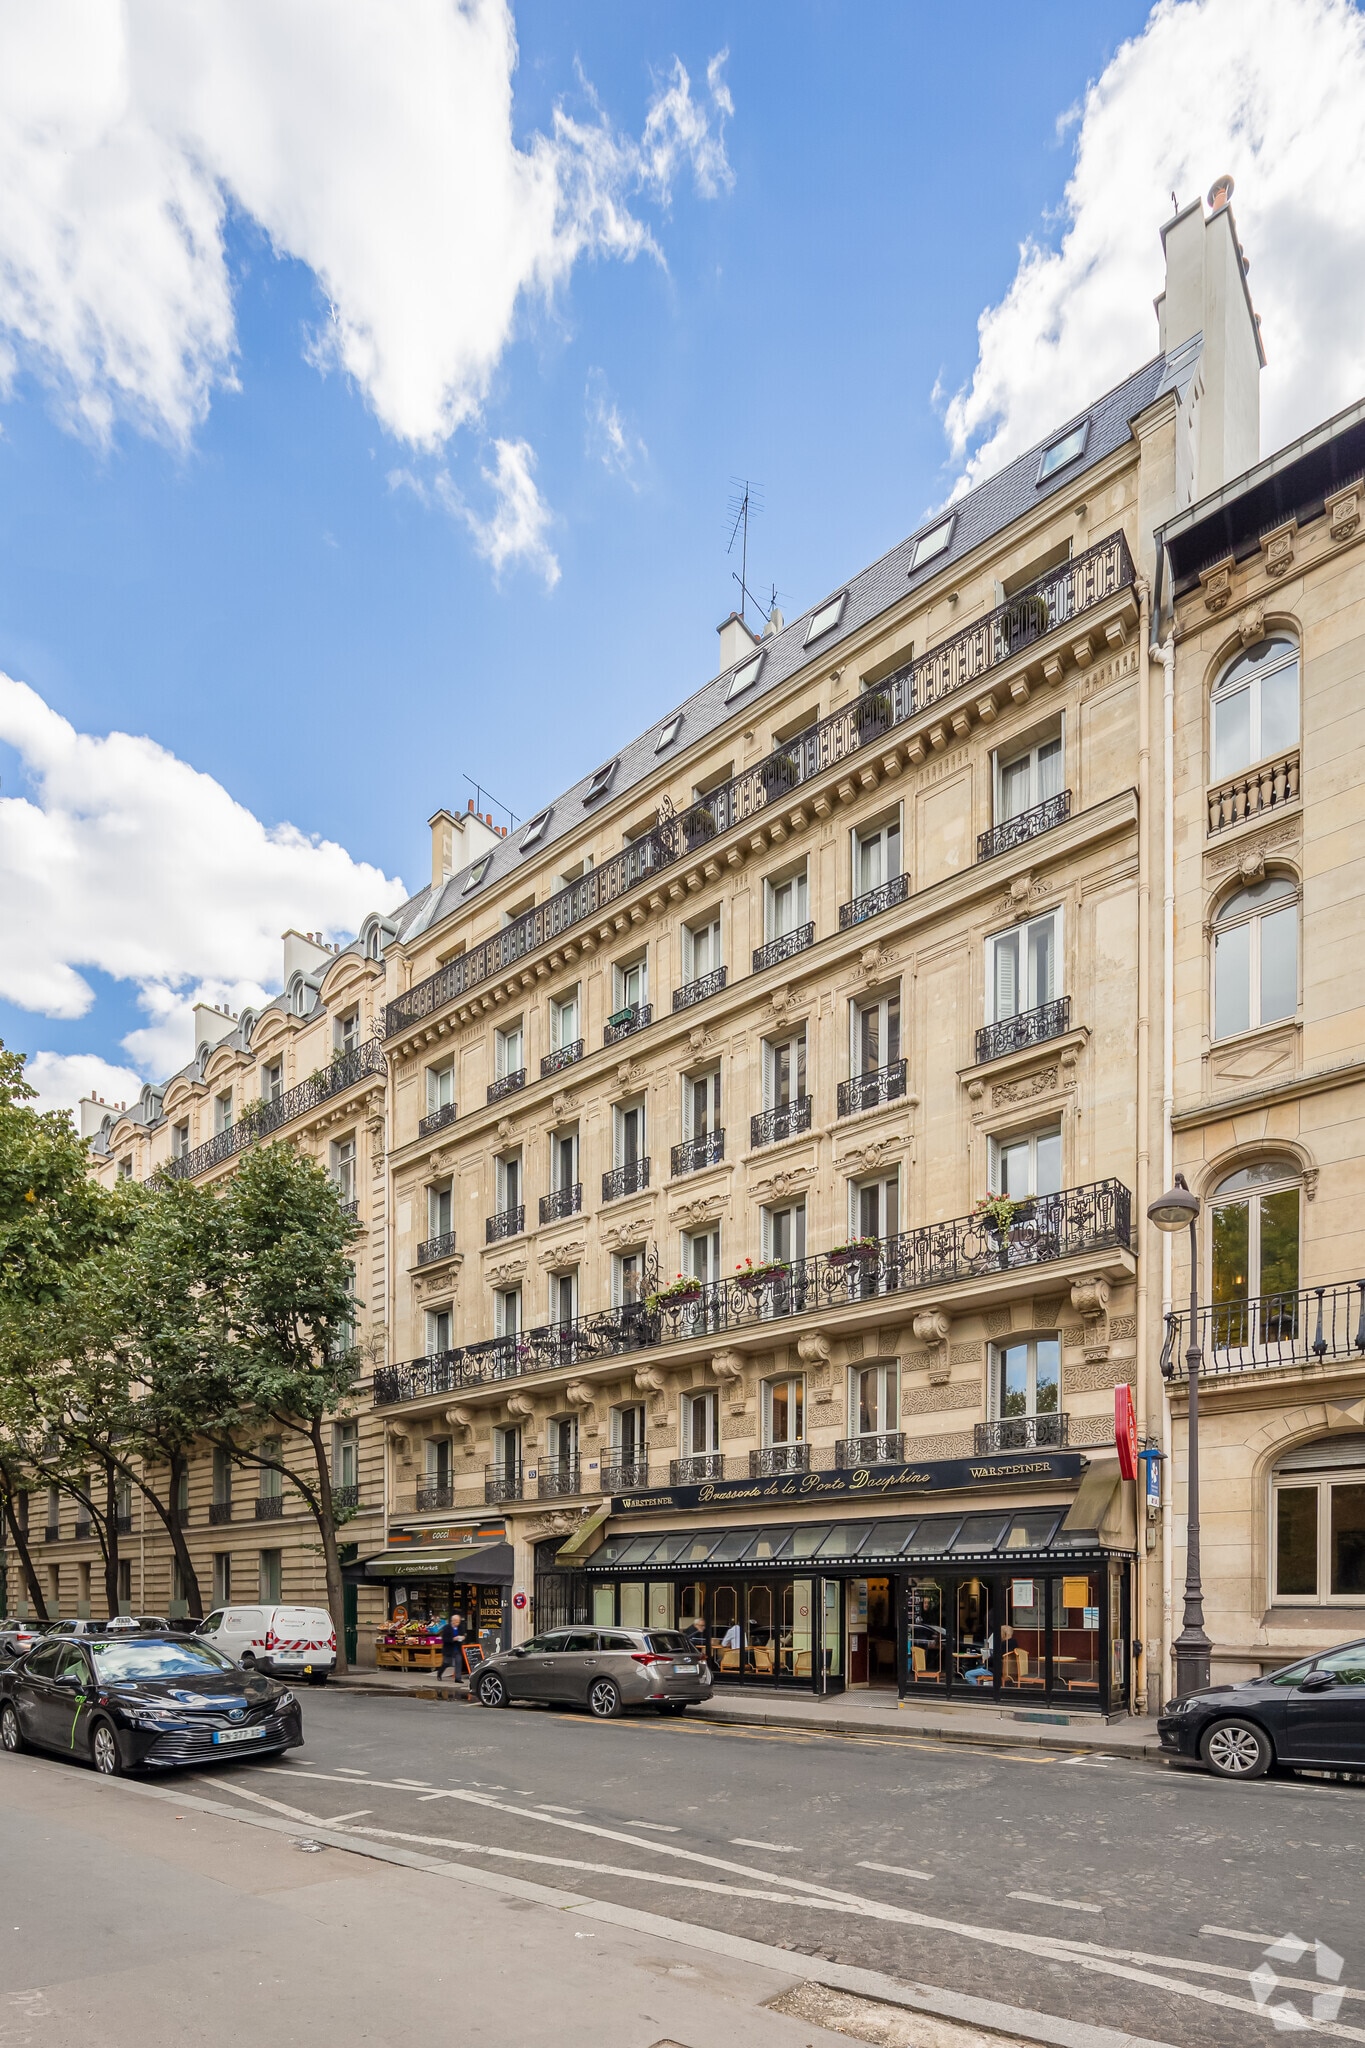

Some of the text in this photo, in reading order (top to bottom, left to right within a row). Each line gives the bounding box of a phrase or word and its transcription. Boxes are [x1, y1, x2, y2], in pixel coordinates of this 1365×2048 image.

[969, 1461, 1052, 1478] WARSTEINER
[763, 1479, 779, 1496] de
[780, 1479, 797, 1495] la
[800, 1474, 845, 1492] Porte
[849, 1468, 931, 1492] Dauphine
[621, 1496, 673, 1509] WARSTEINER
[483, 1588, 499, 1596] CAVE
[483, 1598, 499, 1606] VINS
